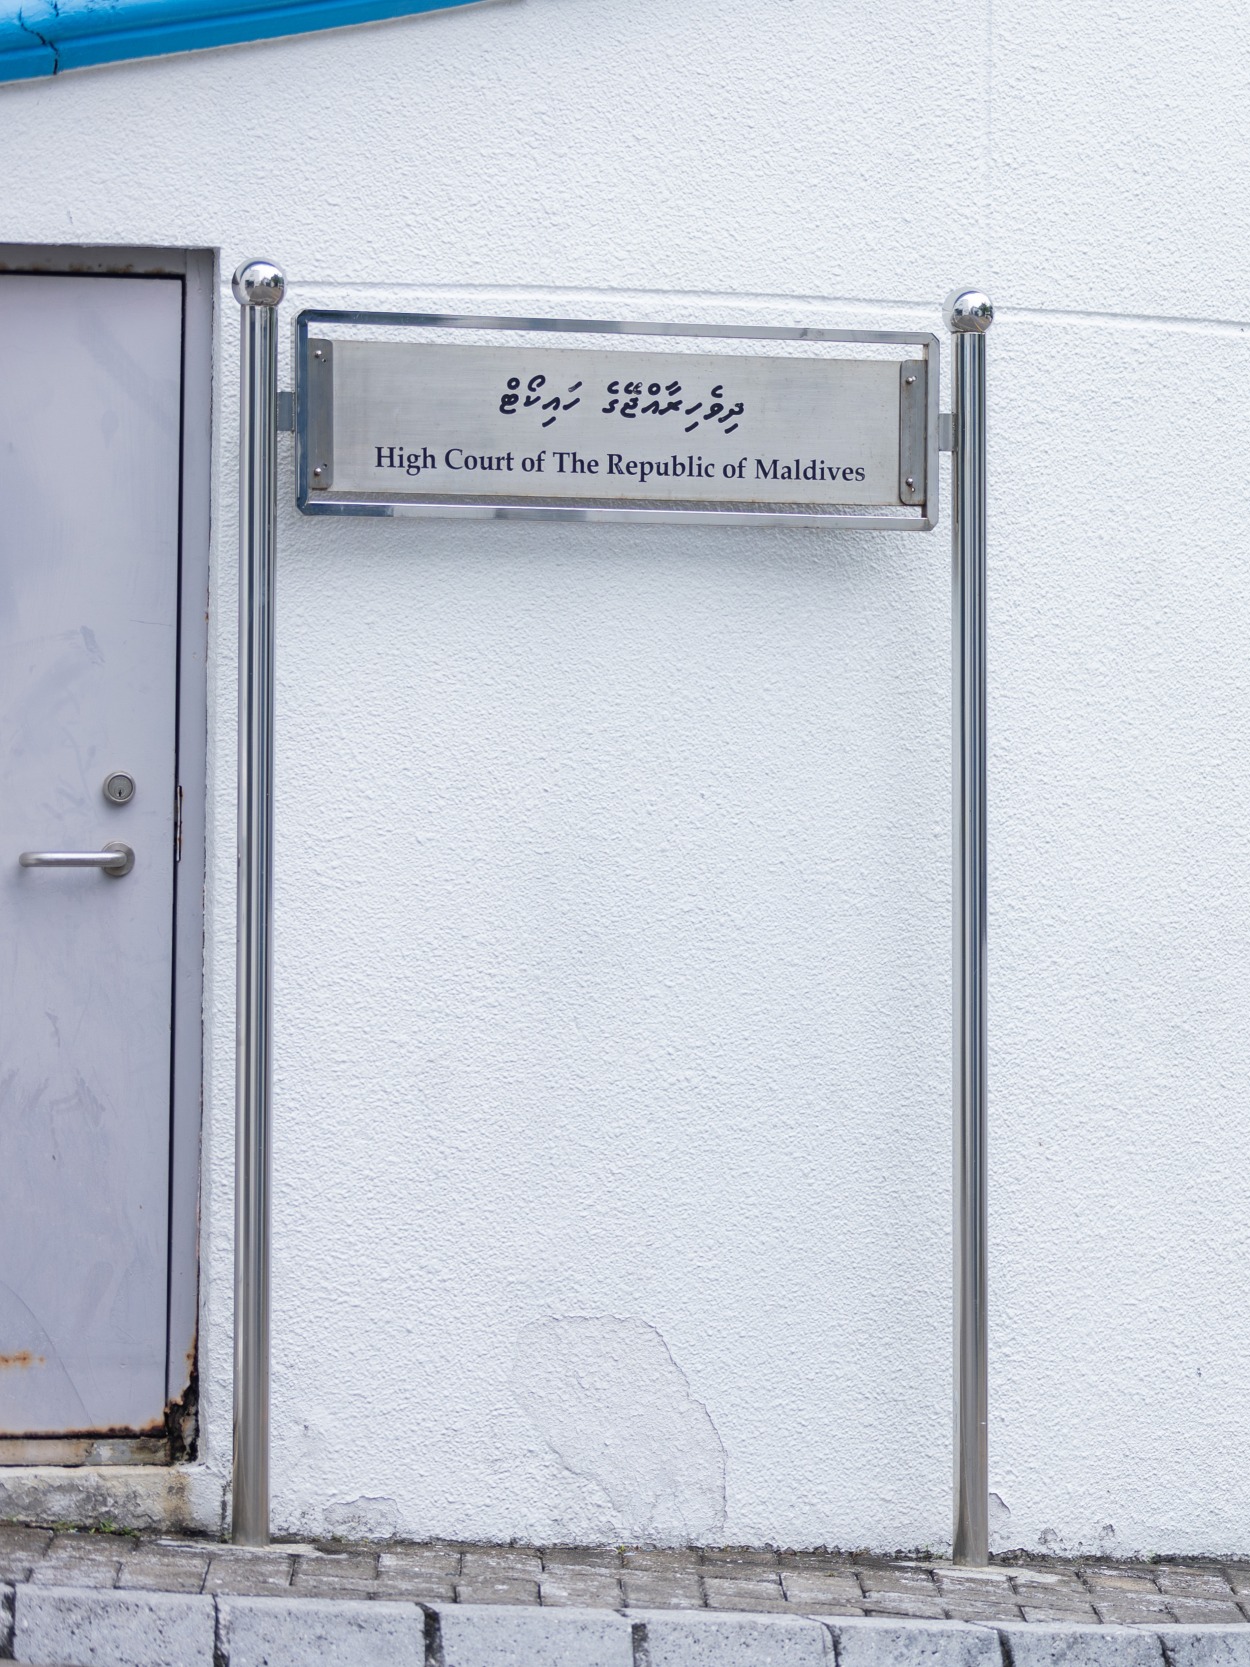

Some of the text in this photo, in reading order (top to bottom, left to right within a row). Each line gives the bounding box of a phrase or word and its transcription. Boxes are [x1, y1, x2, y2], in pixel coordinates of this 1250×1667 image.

[602, 381, 745, 434] ދިވެހިރާއްޖޭގެ
[374, 446, 867, 484] High Court of The Republic of Maldives
